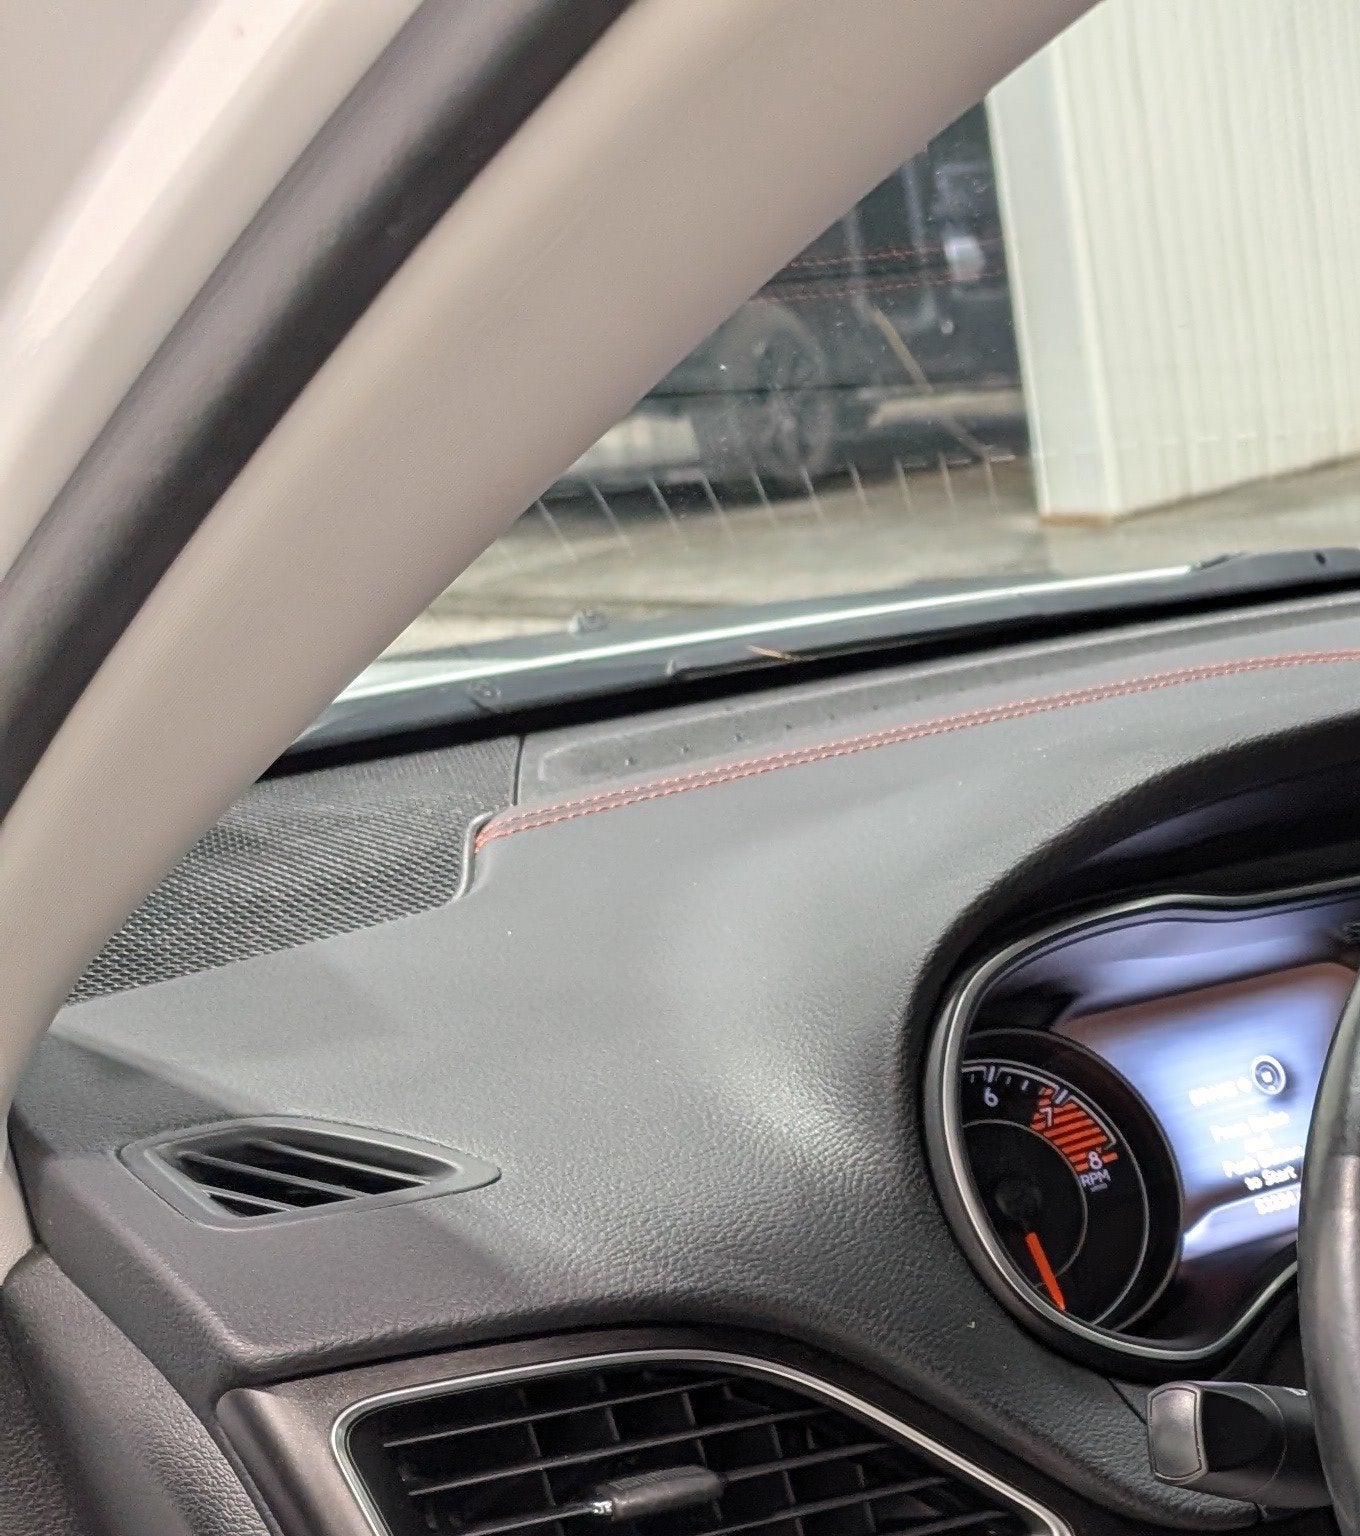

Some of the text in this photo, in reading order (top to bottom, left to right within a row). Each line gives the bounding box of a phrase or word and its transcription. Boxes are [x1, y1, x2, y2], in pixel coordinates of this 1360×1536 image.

[984, 1086, 999, 1107] 6
[1039, 1106, 1053, 1127] 7
[1087, 1151, 1103, 1170] 8
[1080, 1168, 1112, 1187] RPM
[1261, 1165, 1298, 1186] Start
